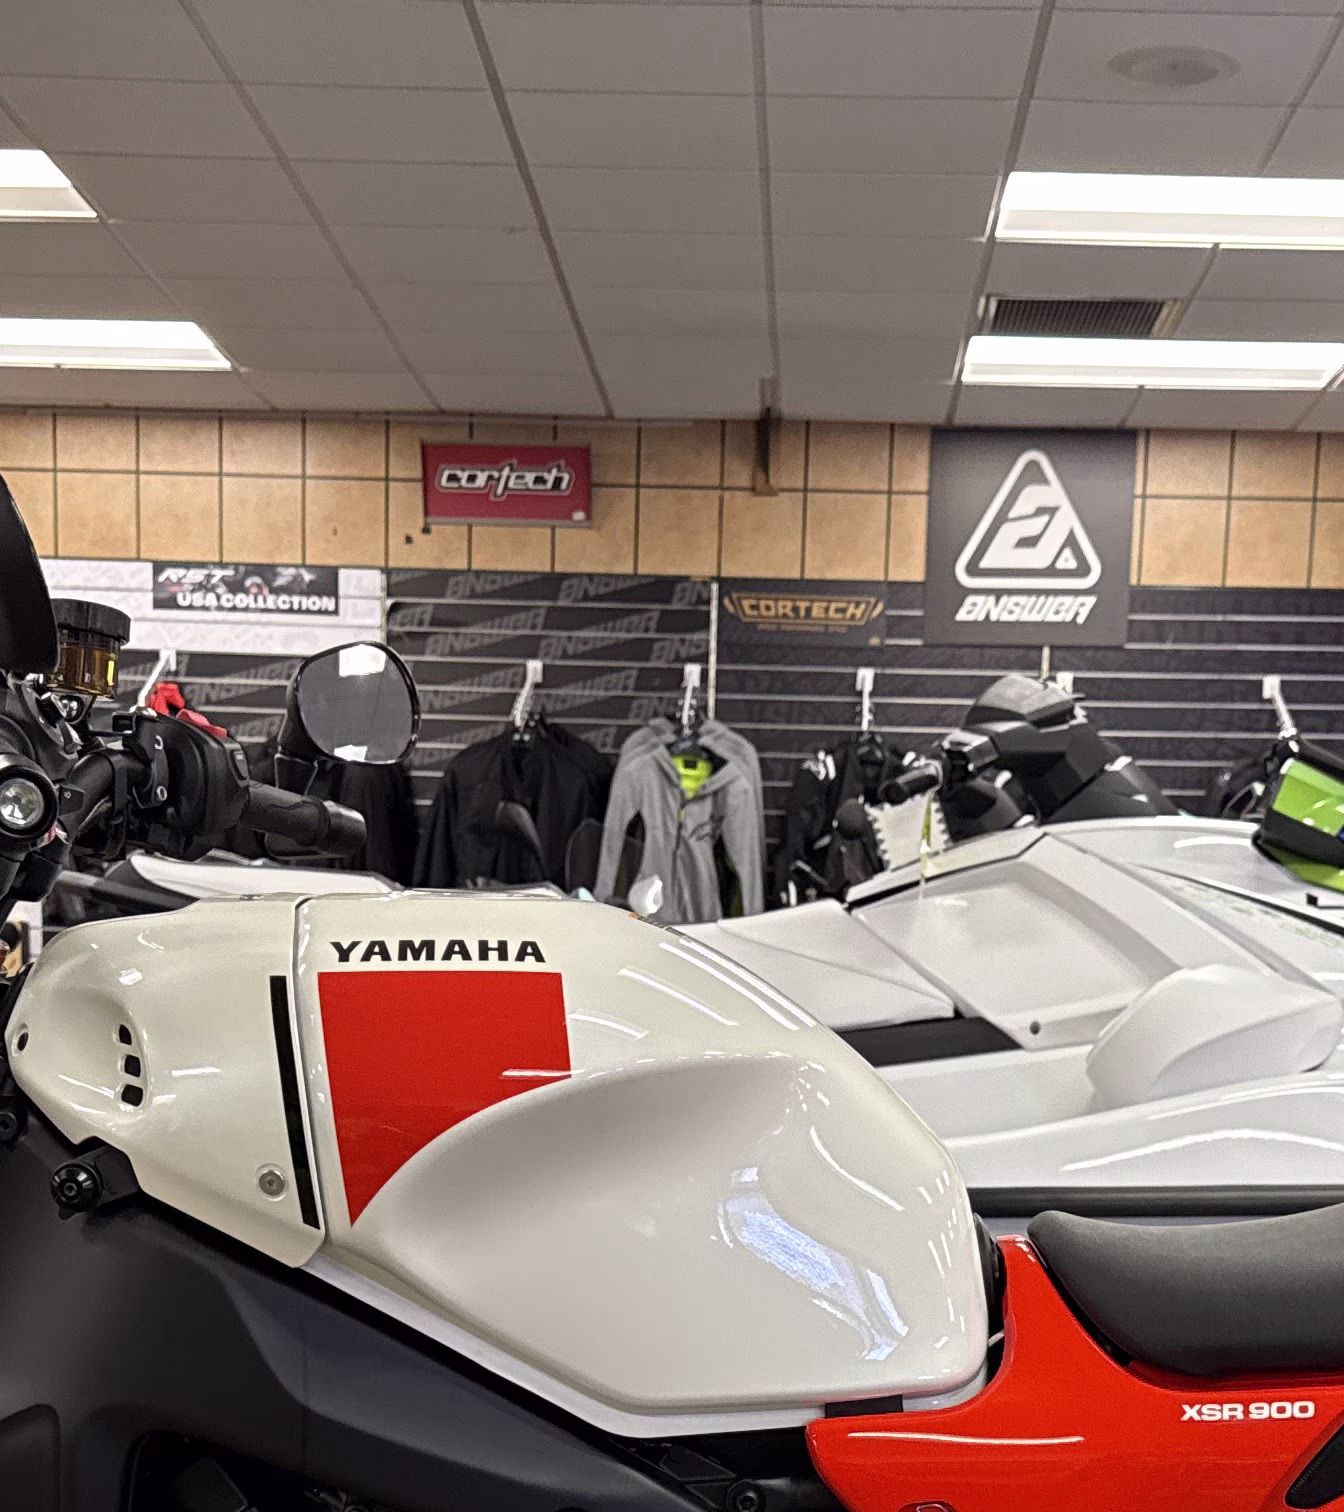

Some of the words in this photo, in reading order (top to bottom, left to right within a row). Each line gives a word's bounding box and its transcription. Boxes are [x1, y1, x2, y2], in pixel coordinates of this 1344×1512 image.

[158, 566, 235, 585] RST
[176, 592, 218, 608] USA
[219, 593, 336, 612] COLLECTION
[740, 600, 868, 621] CORTECH
[954, 593, 1099, 625] ANSWER
[329, 939, 547, 963] YAMAHA
[1180, 1402, 1245, 1422] XSR
[1248, 1400, 1316, 1420] 900
